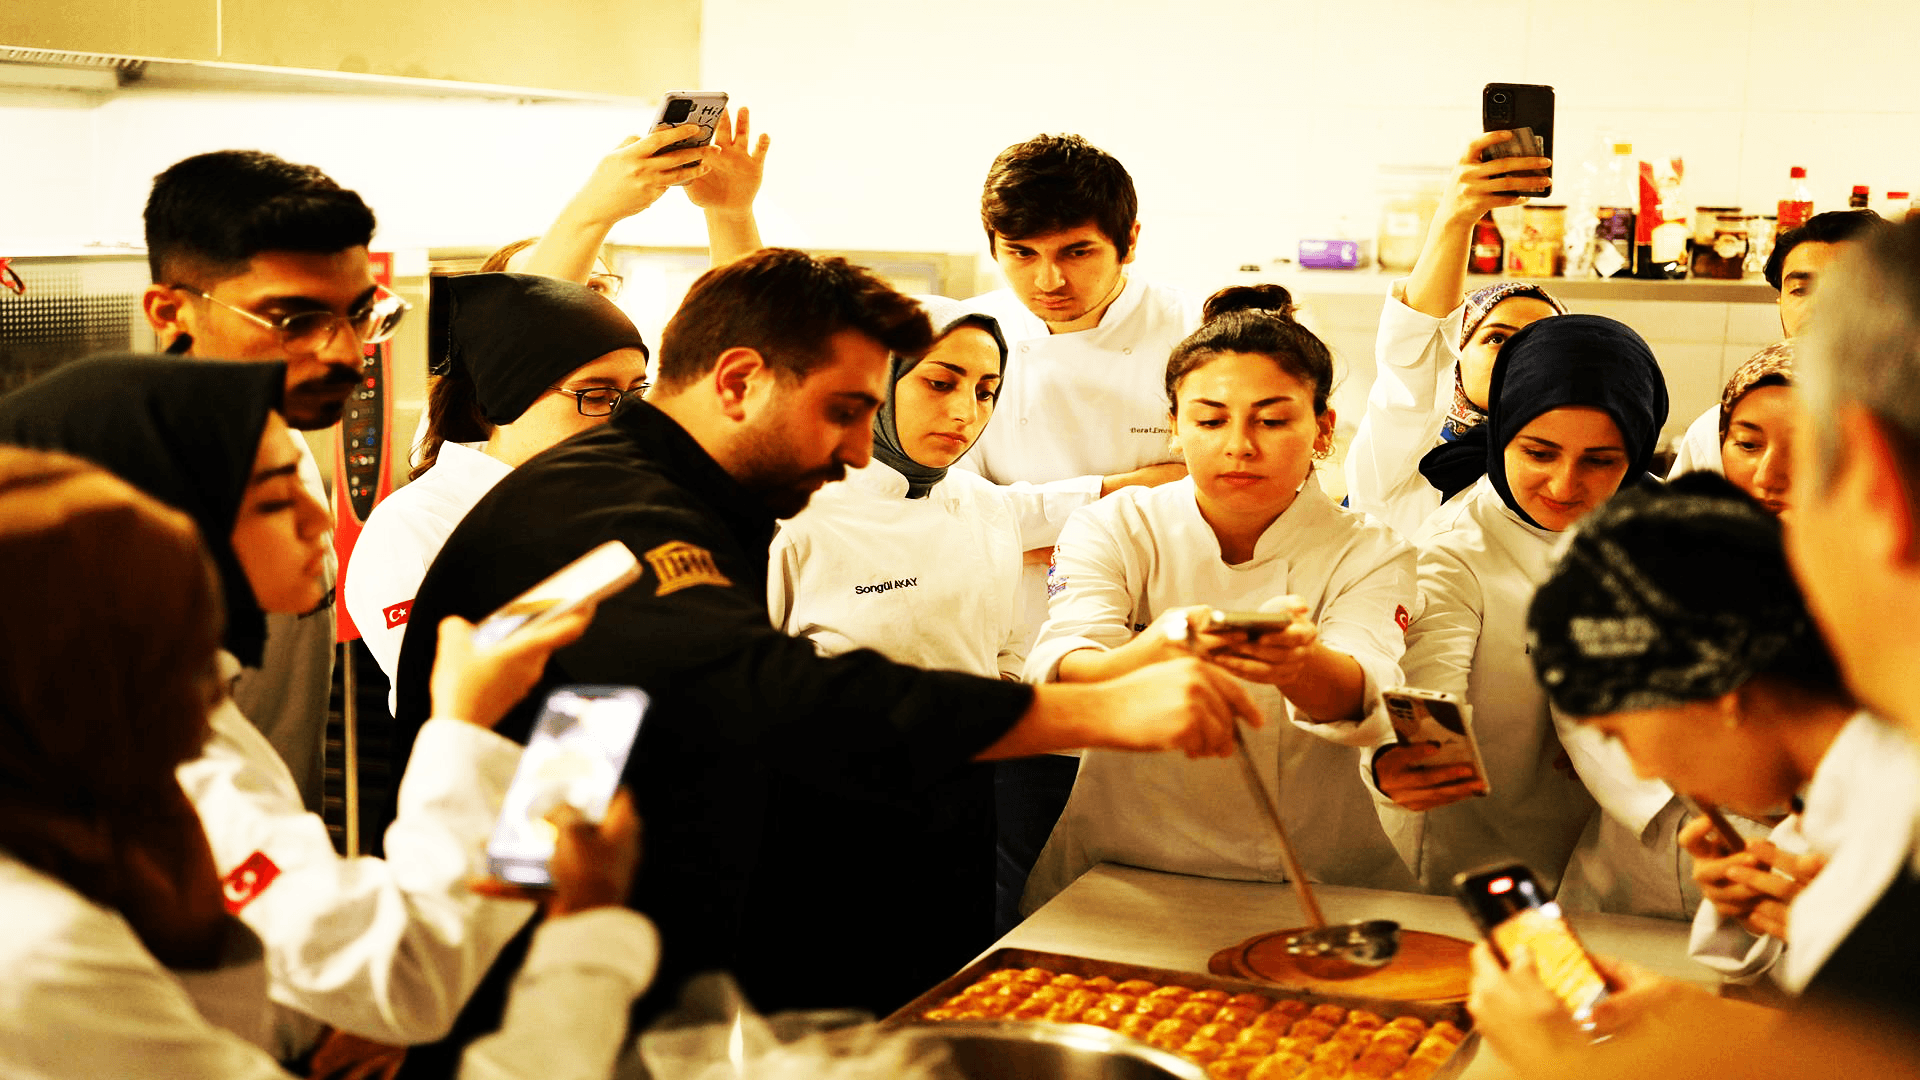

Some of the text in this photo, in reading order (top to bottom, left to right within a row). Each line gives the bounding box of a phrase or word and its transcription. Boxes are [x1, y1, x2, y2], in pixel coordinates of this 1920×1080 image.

[701, 105, 724, 118] Hi!
[855, 577, 918, 595] Songül AKAY
